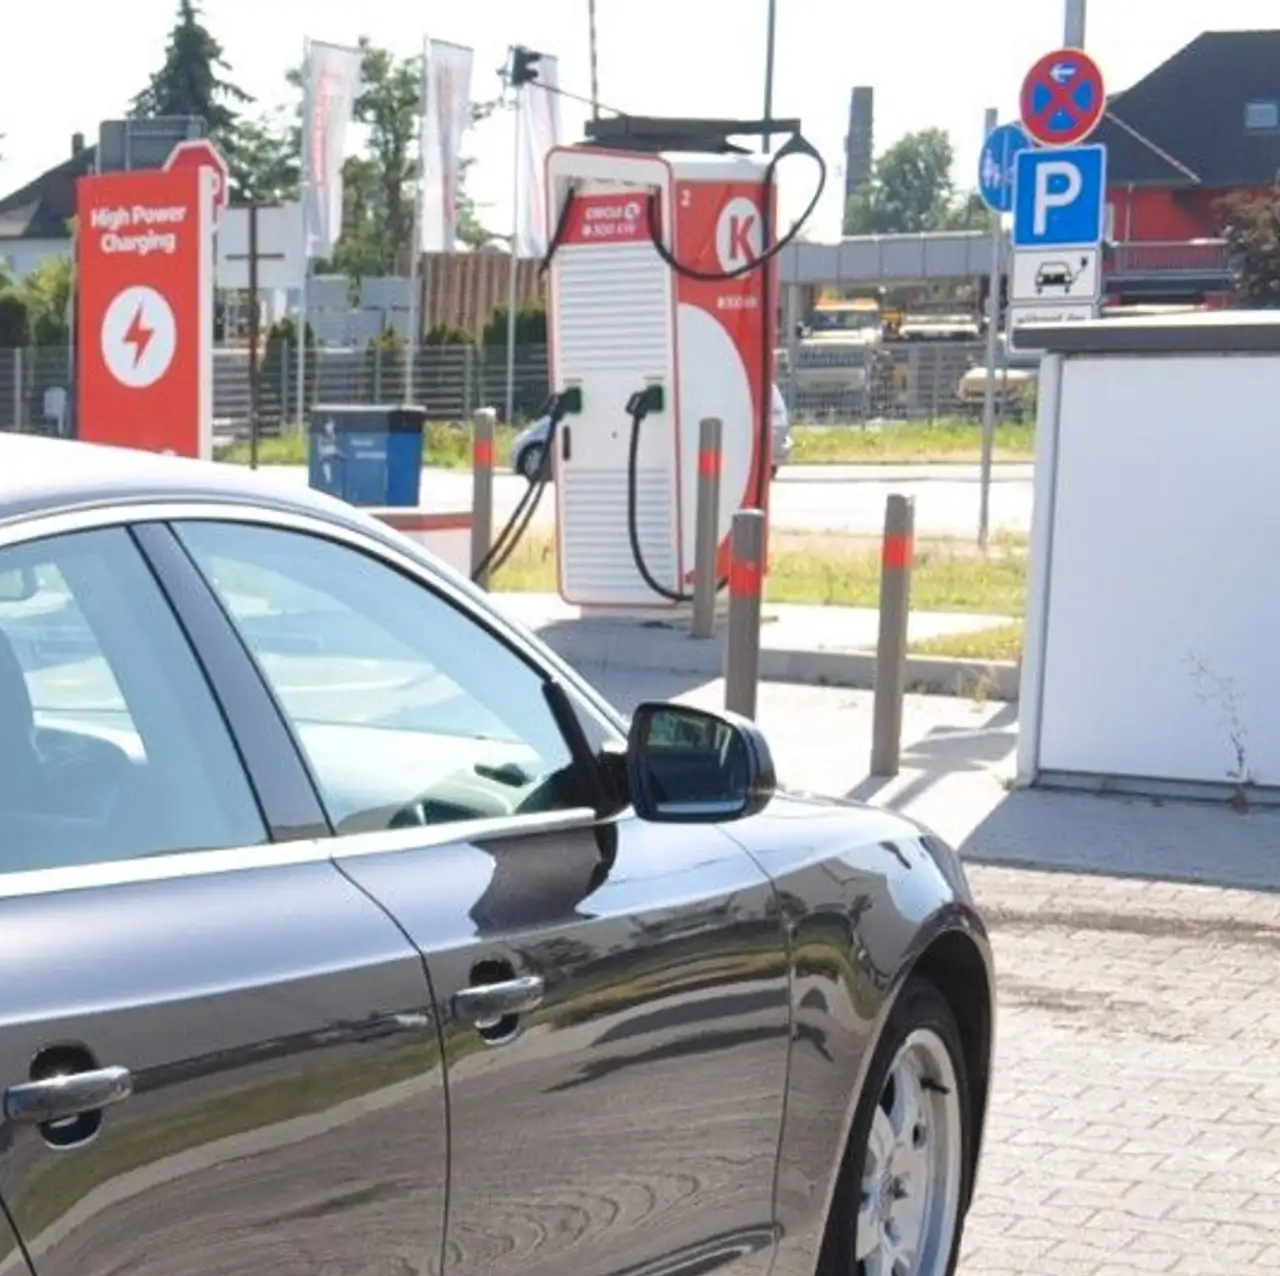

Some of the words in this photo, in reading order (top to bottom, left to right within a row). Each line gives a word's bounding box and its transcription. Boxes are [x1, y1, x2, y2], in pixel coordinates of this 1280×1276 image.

[90, 206, 130, 231] High
[132, 205, 187, 226] Power
[1033, 161, 1083, 236] P
[101, 229, 176, 256] Charging
[728, 214, 757, 265] K
